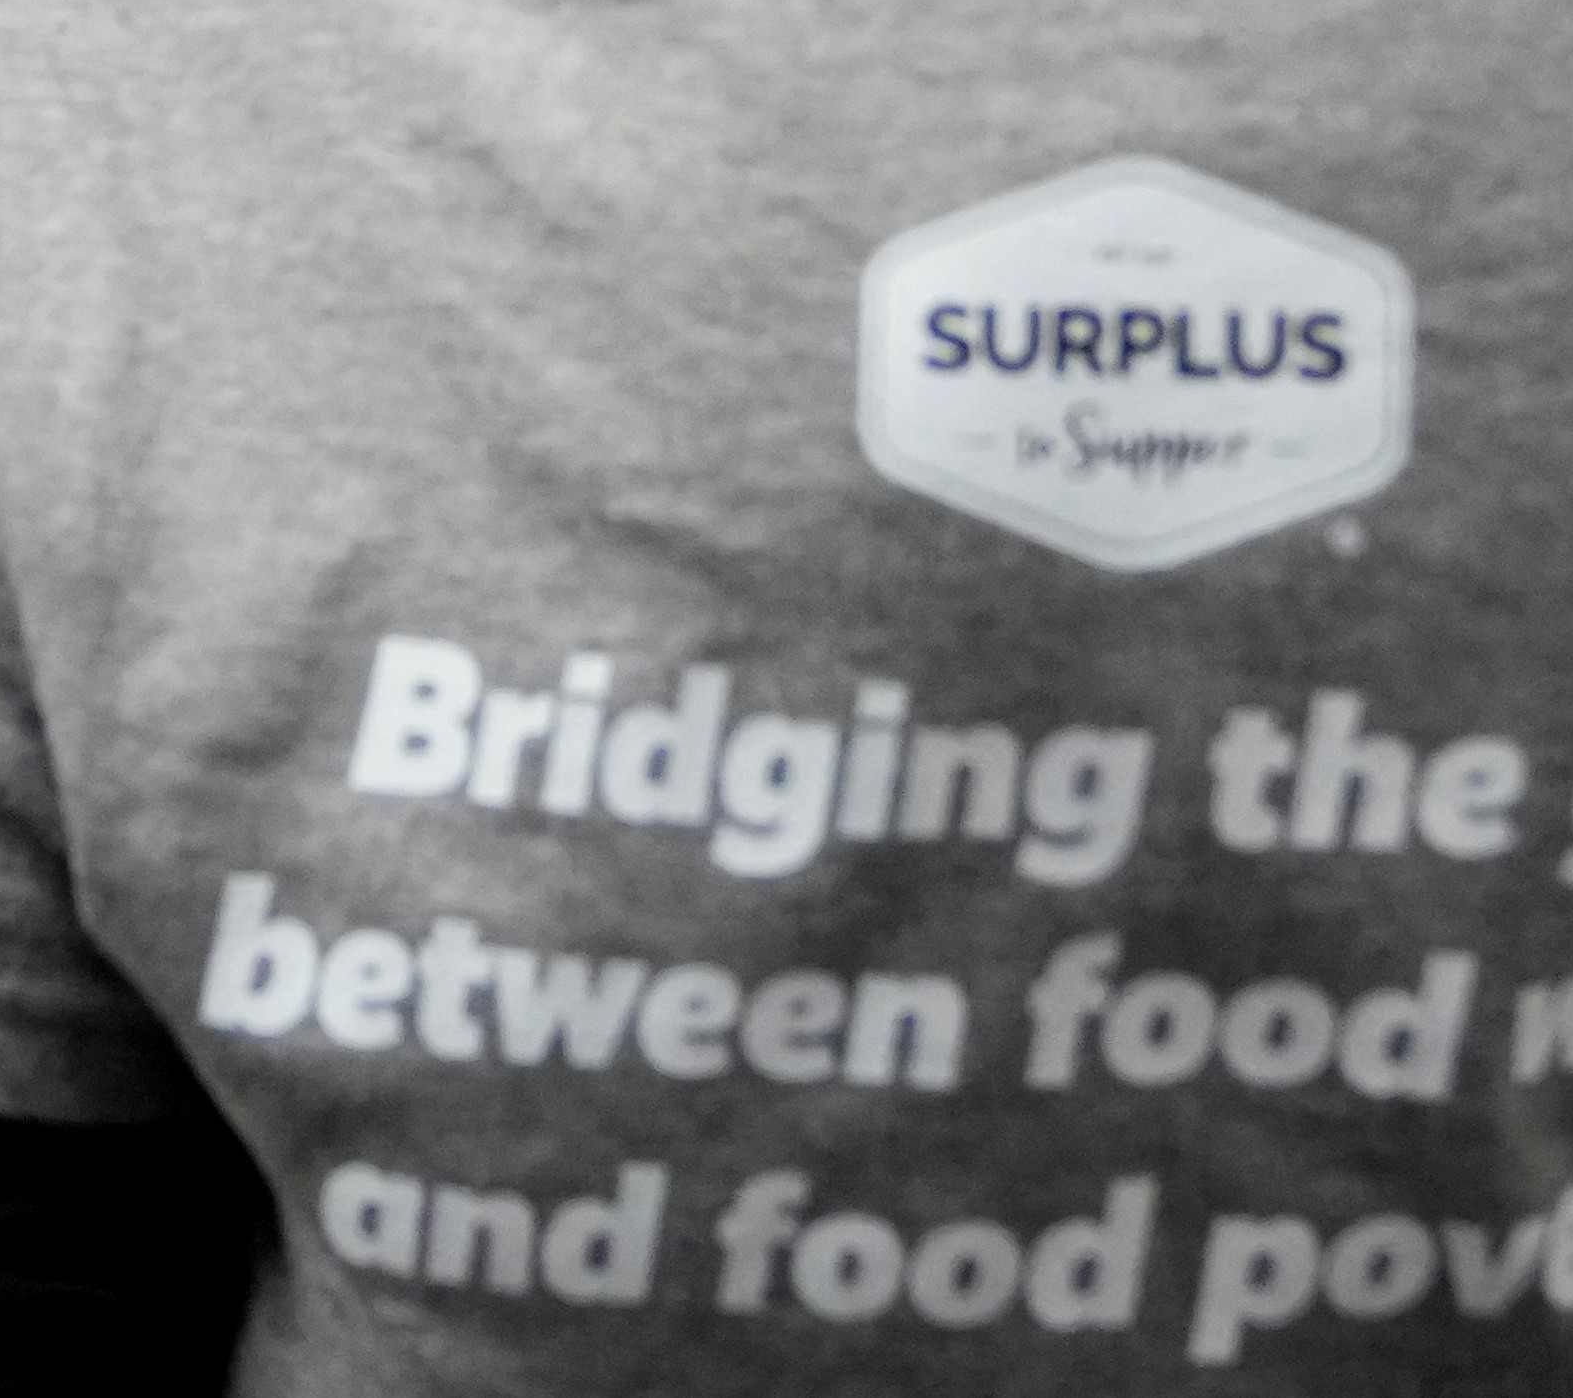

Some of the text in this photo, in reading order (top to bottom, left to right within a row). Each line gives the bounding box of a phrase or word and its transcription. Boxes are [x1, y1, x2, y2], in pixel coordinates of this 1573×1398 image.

[923, 303, 1347, 380] SURPLUS
[348, 635, 1155, 887] Bridging
[1210, 688, 1528, 859] the
[197, 871, 968, 1092] between
[1025, 932, 1478, 1102] food
[318, 1161, 670, 1304] and
[715, 1168, 1159, 1332] food
